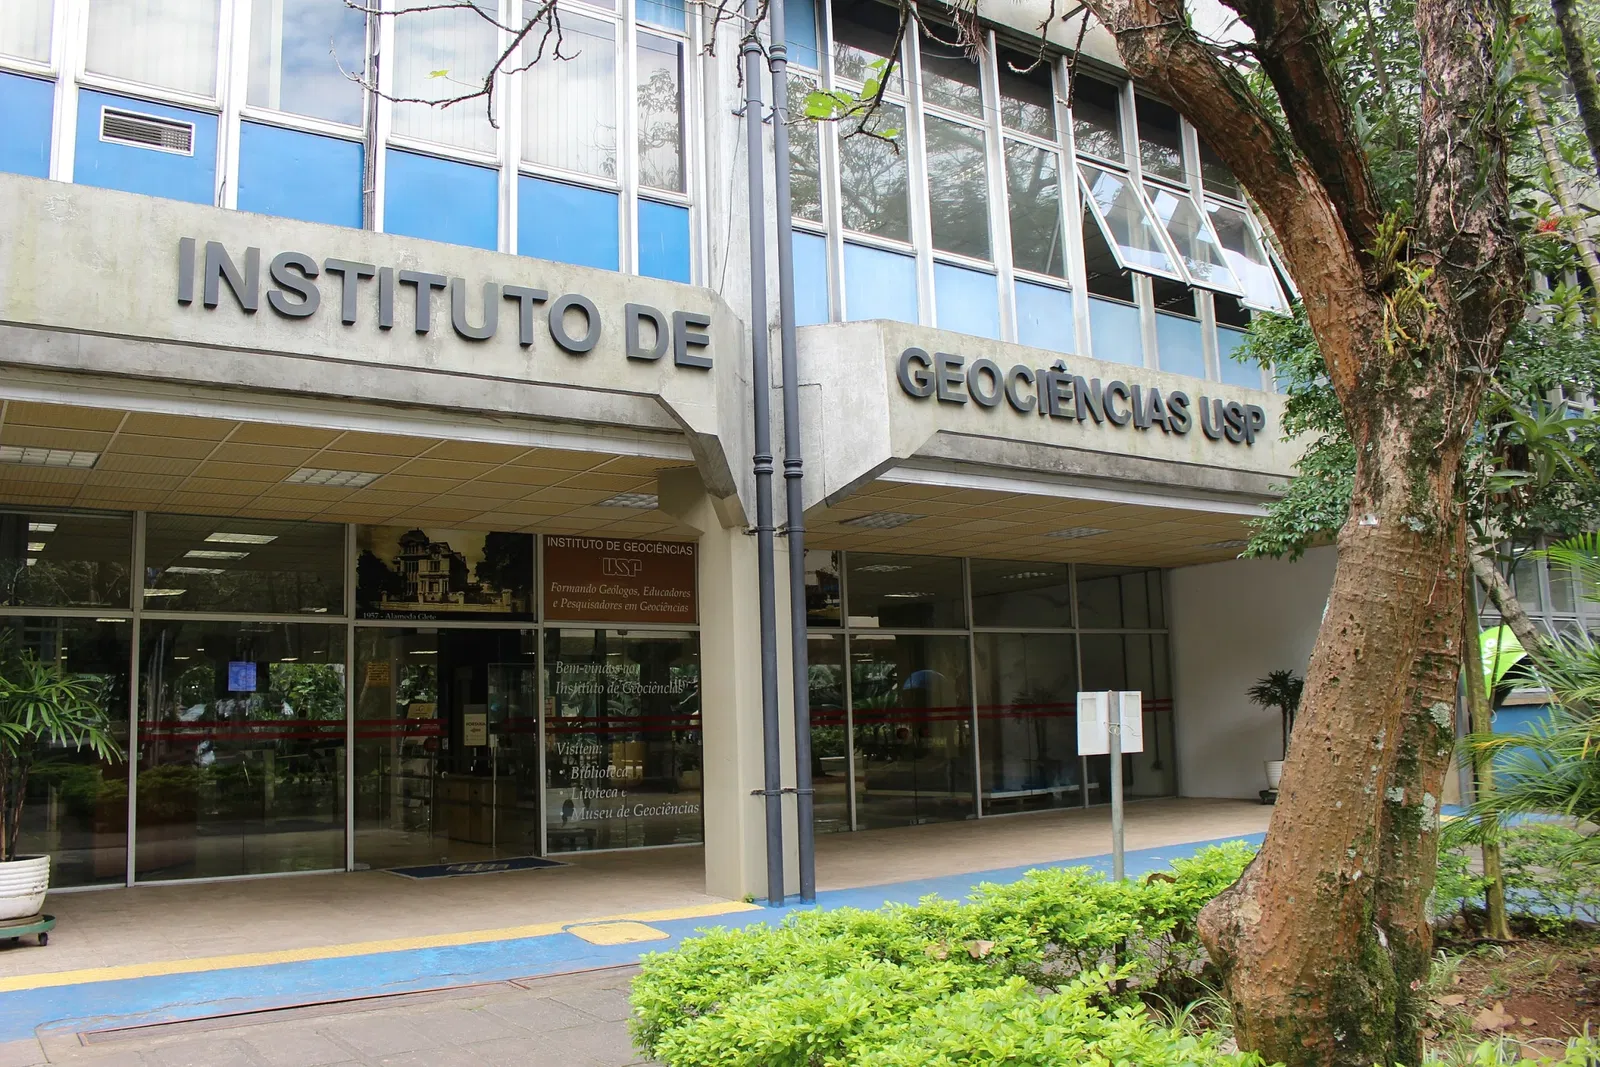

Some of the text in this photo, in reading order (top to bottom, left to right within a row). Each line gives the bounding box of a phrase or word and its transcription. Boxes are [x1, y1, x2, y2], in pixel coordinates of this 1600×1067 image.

[177, 235, 714, 370] INSTITUTO DE
[896, 347, 1266, 446] GEOCIÊNCIAS USP
[547, 537, 693, 556] INSTITUTO DE GEOCIÊNCIAS
[602, 557, 643, 577] USP
[551, 581, 691, 598] Formando Geólogos, Educadores
[552, 597, 689, 613] e Pesquisadores em Geociências
[556, 660, 621, 674] Bem-vindos
[555, 680, 684, 695] Instituto de Geociências
[556, 742, 603, 755] Visitem:
[571, 765, 629, 780] Biblioteca
[571, 786, 618, 800] Litoteca
[571, 801, 700, 820] Museu de Geociências
